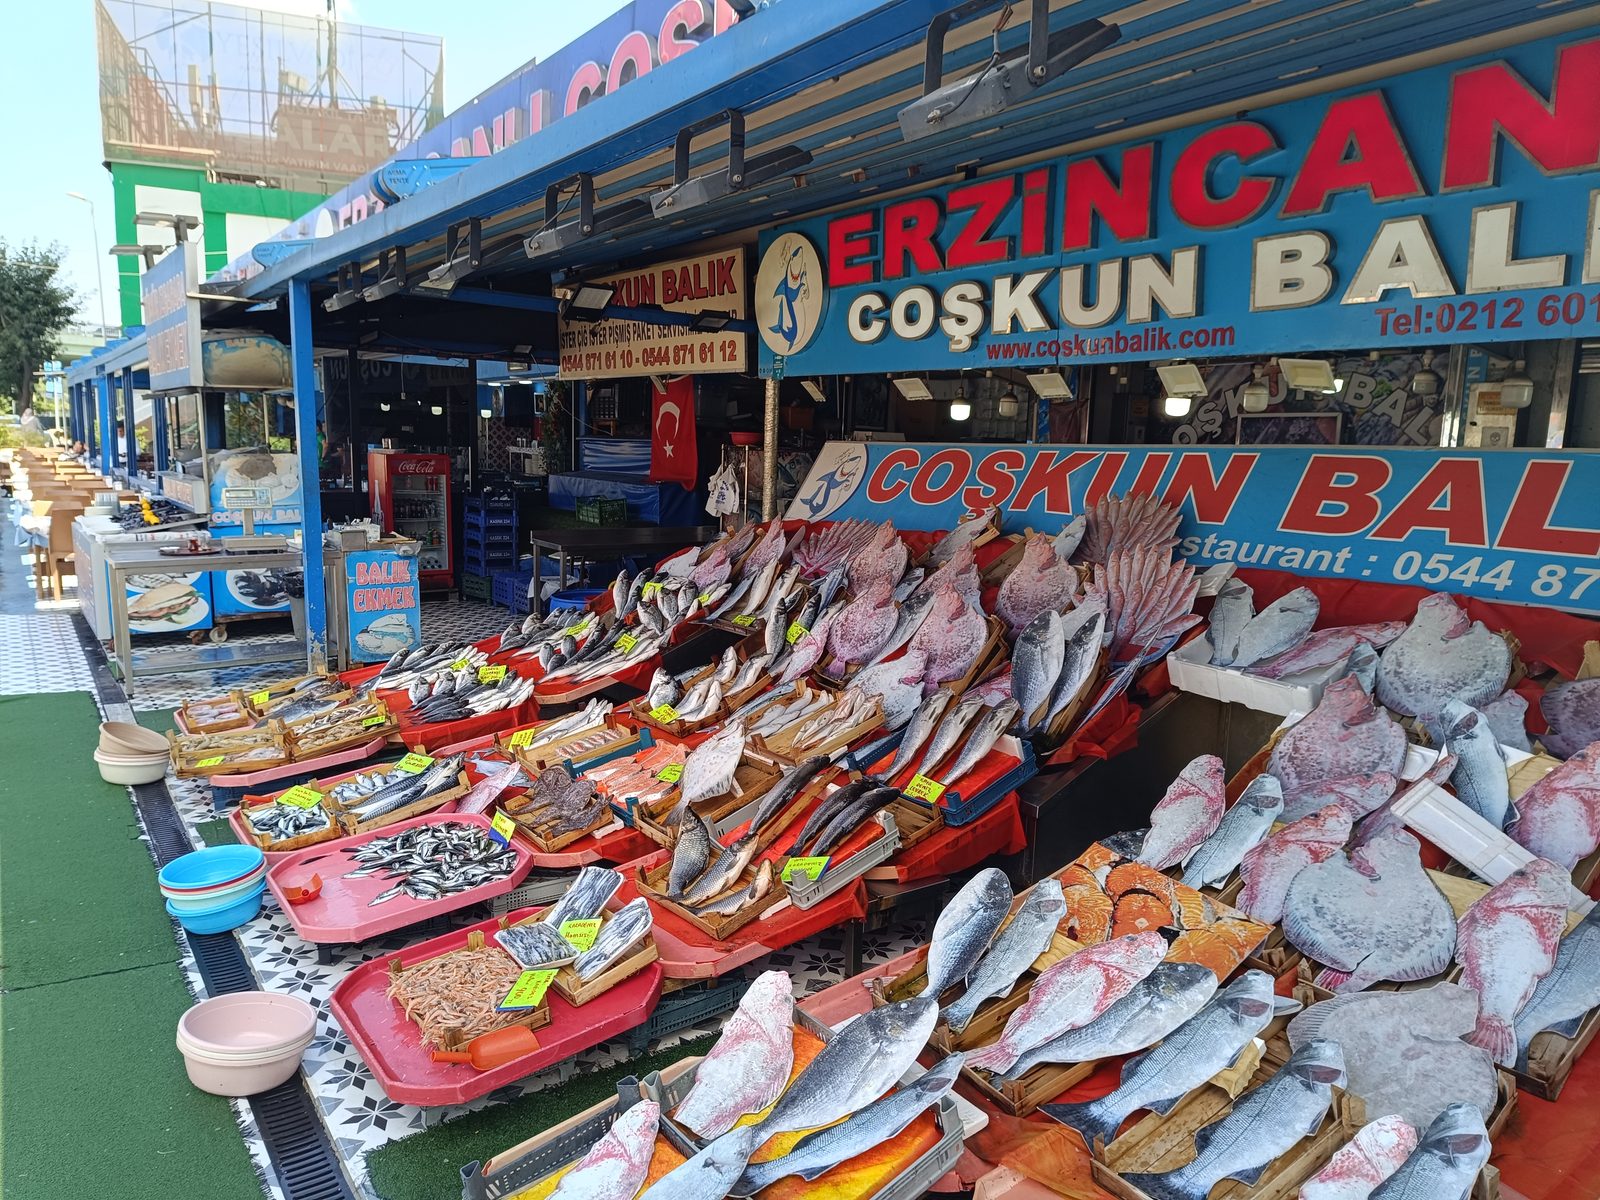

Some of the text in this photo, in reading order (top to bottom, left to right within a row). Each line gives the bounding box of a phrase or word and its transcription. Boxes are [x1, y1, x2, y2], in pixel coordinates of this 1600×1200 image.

[662, 256, 737, 304] BALIK
[847, 247, 1200, 353] COŞKUN
[1374, 297, 1526, 337] Tel:0212
[561, 353, 584, 373] 0544
[585, 351, 602, 371] 871
[605, 350, 617, 370] 61
[620, 349, 633, 369] 10
[642, 345, 670, 367] 0544
[673, 343, 695, 365] 871
[700, 341, 715, 363] 61
[719, 339, 738, 362] 12
[986, 325, 1236, 360] www.coskunbalik.com
[866, 448, 1260, 526] COŞKUN
[355, 559, 411, 586] BALIK
[1180, 532, 1352, 575] staurant
[1392, 549, 1513, 592] 0544
[1531, 563, 1600, 601] 87
[353, 586, 416, 613] EKMEK
